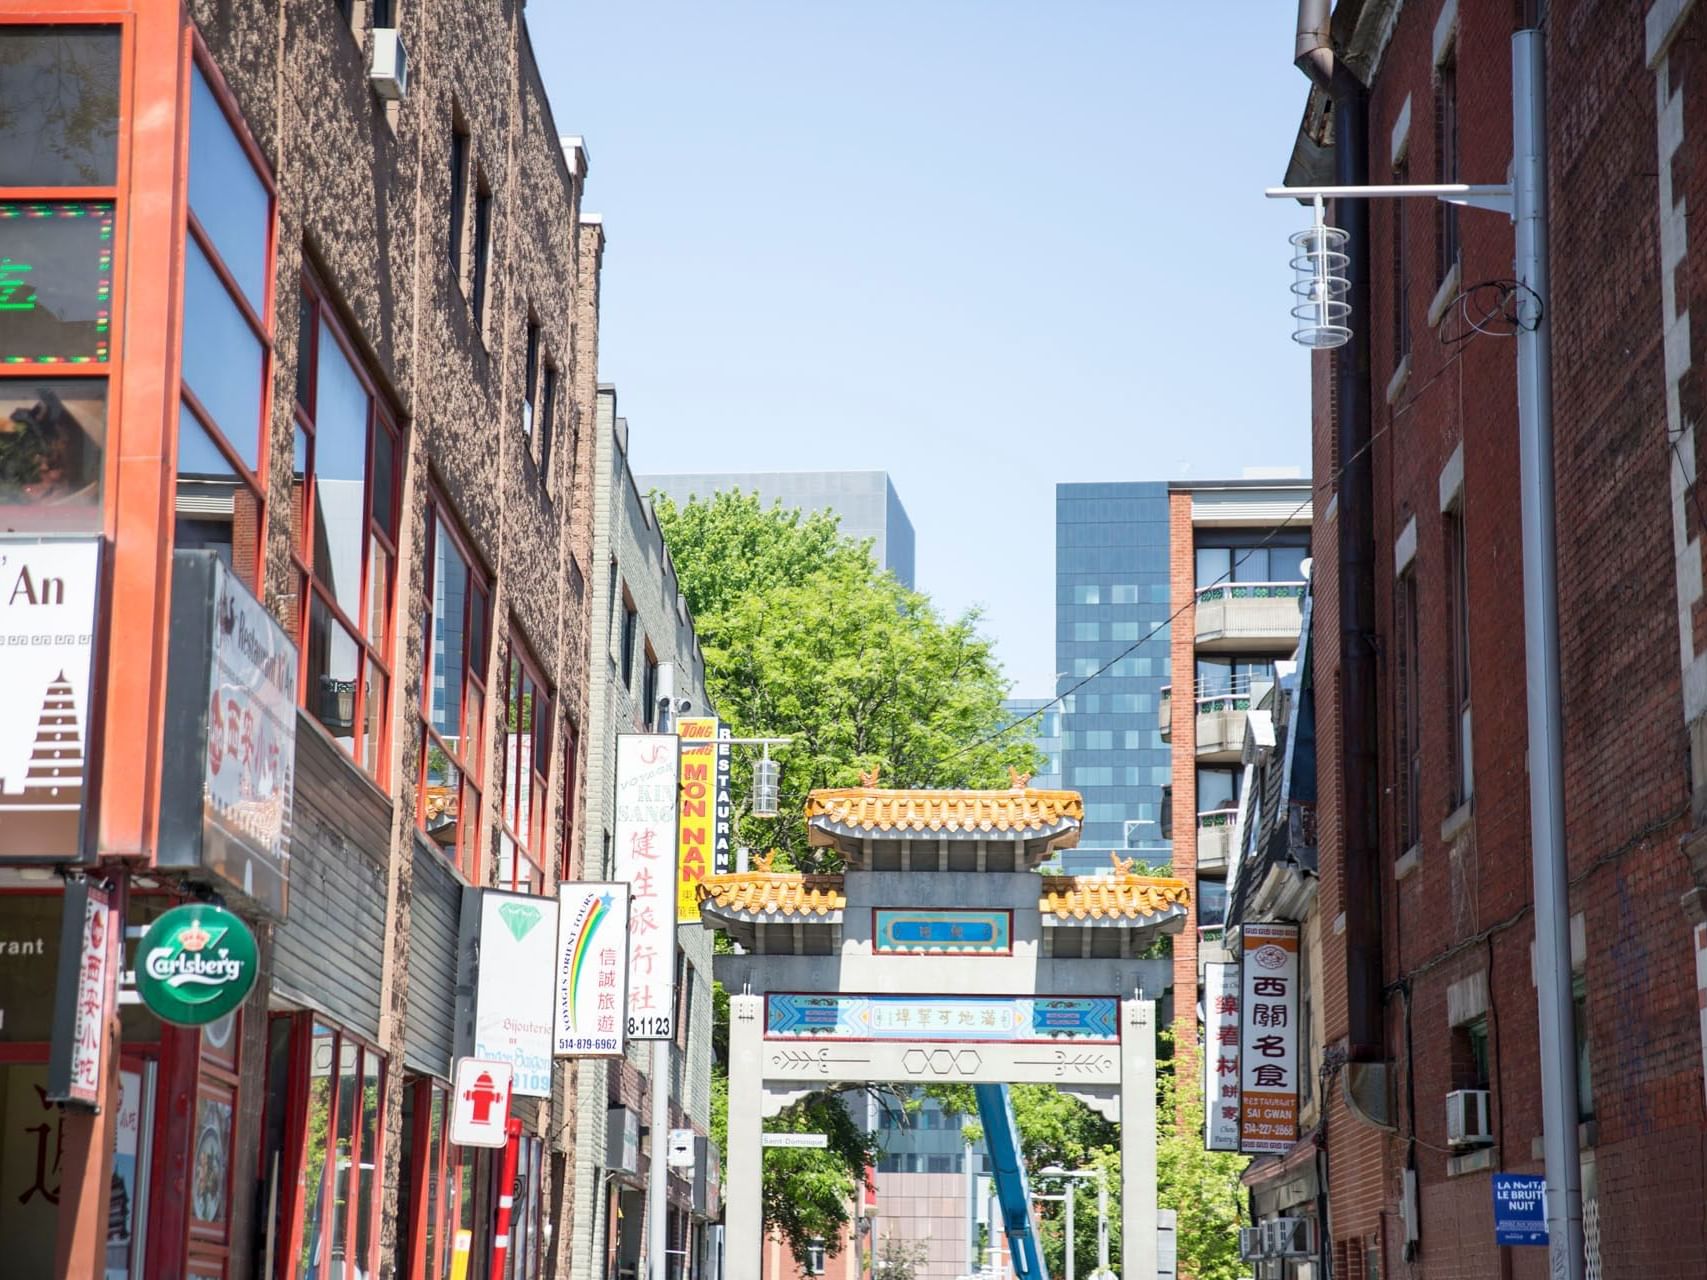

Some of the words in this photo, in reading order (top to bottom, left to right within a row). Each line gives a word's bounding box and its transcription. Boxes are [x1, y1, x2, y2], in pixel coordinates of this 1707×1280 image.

[680, 722, 713, 738] TONG
[683, 764, 707, 817] MON
[682, 828, 705, 882] NAN
[574, 892, 595, 927] TOURS
[146, 948, 240, 980] Carlsberg
[1247, 1108, 1261, 1119] SAI
[1263, 1108, 1293, 1120] GWAN
[1497, 1181, 1511, 1190] LA
[1497, 1190, 1509, 1200] LE
[1511, 1190, 1543, 1200] BRUIT
[1508, 1201, 1535, 1211] NUIT
